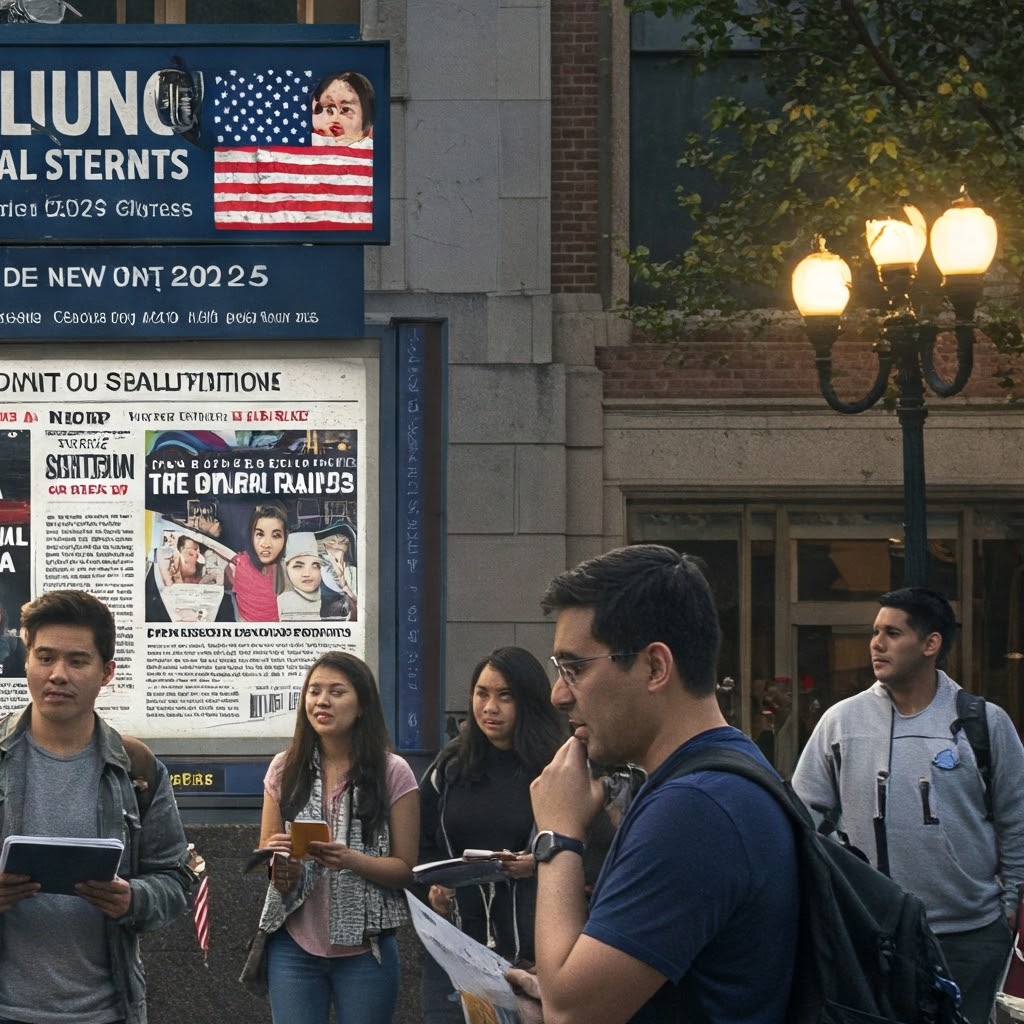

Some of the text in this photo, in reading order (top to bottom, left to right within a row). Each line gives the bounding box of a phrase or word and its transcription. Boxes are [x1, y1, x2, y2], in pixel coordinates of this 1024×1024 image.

[45, 149, 189, 181] STERNTS
[3, 267, 38, 287] DE
[48, 266, 106, 287] NEW
[66, 372, 98, 392] OU
